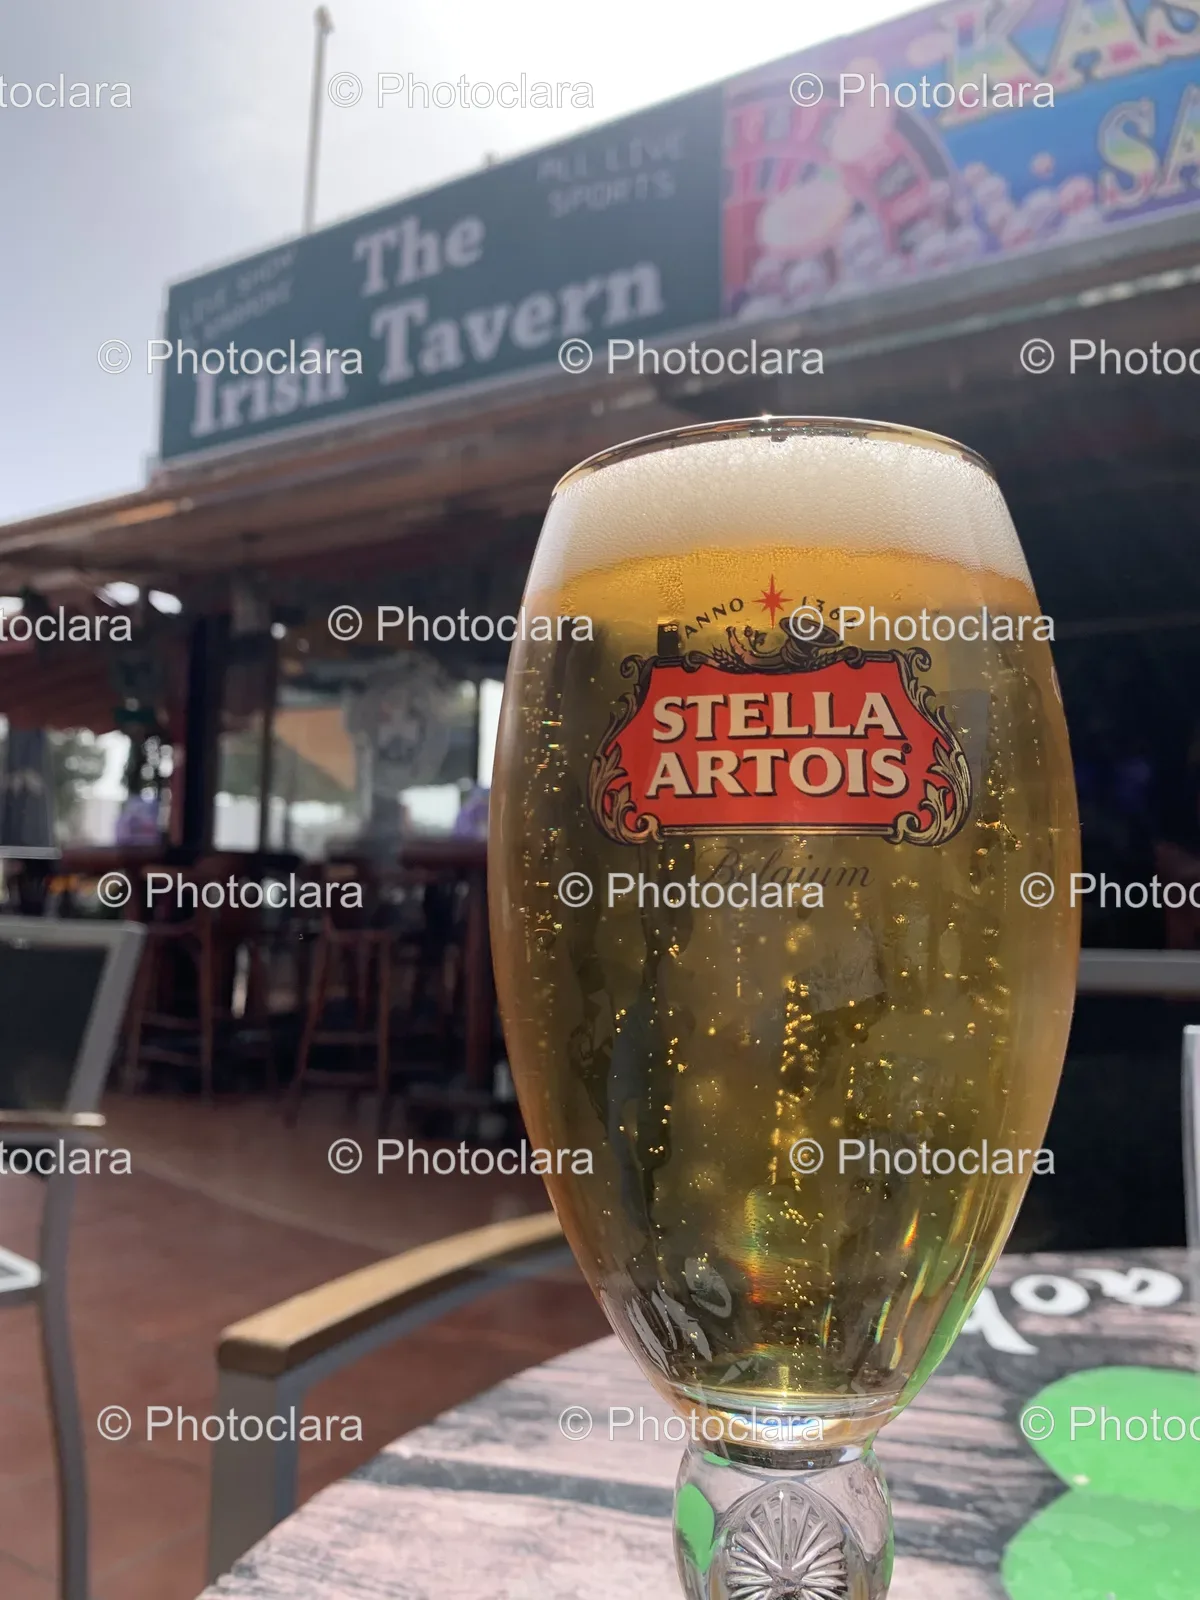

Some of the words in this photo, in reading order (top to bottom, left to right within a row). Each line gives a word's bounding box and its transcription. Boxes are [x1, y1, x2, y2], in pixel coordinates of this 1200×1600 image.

[353, 214, 484, 298] The
[369, 260, 664, 386] Tavern
[190, 332, 350, 437] Irish
[684, 598, 744, 639] ANNO
[652, 691, 907, 742] STELLA
[645, 747, 911, 799] ARTOIS
